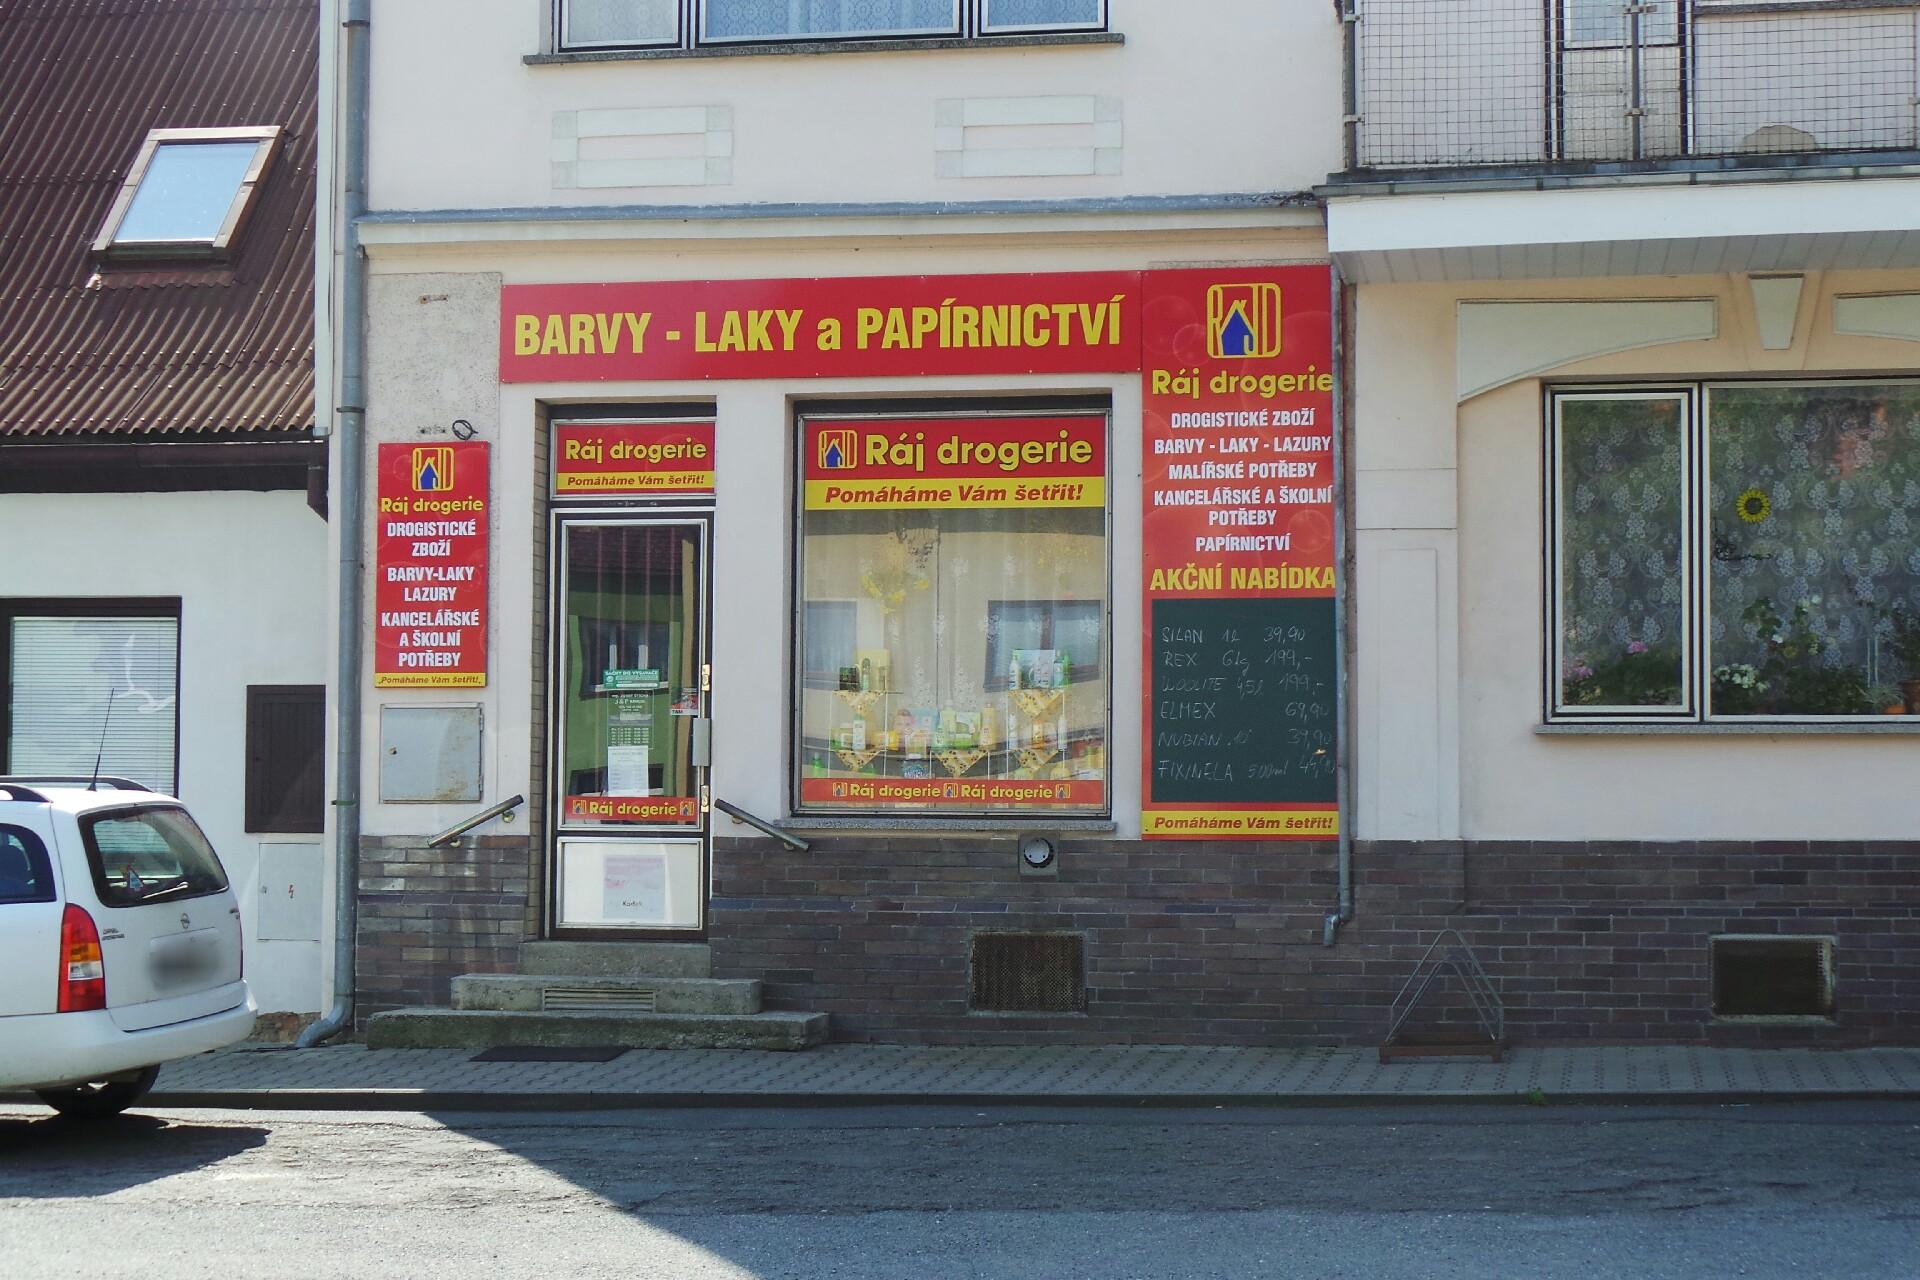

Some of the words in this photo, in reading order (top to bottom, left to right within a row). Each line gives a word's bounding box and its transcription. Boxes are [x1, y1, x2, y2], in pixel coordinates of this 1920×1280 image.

[514, 312, 652, 356] BARVY
[694, 309, 803, 352] LAKY
[816, 317, 841, 350] a
[857, 294, 1127, 350] PAPÍRNICTVÍ
[1152, 367, 1200, 399] Ráj
[1209, 365, 1333, 398] drogerie
[1171, 409, 1268, 428] DROGISTICKÉ
[1272, 408, 1315, 426] ZBOŽÍ
[565, 438, 603, 464] Ráj
[609, 437, 707, 463] drogerie
[865, 431, 925, 472] Ráj
[937, 429, 1093, 471] drogerie
[1154, 439, 1205, 454] BARVY
[1219, 438, 1259, 453] LAKY
[1273, 436, 1331, 452] LAZURY
[1169, 461, 1244, 479] MALÍŘSKÉ
[1249, 460, 1317, 479] POTŘEBY
[567, 476, 635, 486] Pomáháme
[638, 475, 664, 485] Vám
[668, 475, 704, 484] šetřit!
[825, 486, 951, 503] Pomáháme
[957, 485, 1007, 501] Vám
[1014, 483, 1084, 500] šetřit!
[1154, 486, 1261, 506] KANCELÁŘSKÉ
[1265, 489, 1275, 504] A
[1280, 485, 1333, 504] ŠKOLNÍ
[381, 497, 408, 515] Ráj
[412, 496, 484, 515] drogerie
[1209, 508, 1277, 526] POTŘEBY
[387, 519, 476, 537] DROGISTICKÉ
[412, 540, 450, 557] ZBOŽÍ
[1196, 533, 1291, 552] PAPÍRNICTVÍ
[387, 567, 474, 582] BARVY-LAKY
[1150, 562, 1222, 591] AKČNÍ
[1231, 562, 1336, 590] NABÍDKA
[404, 587, 457, 602] LAZURY
[381, 609, 479, 627] KANCELÁŘSKÉ
[399, 632, 409, 646] A
[412, 628, 461, 646] ŠKOLNÍ
[398, 650, 461, 667] POTŘEBY
[1163, 651, 1198, 667] REX
[1160, 701, 1216, 720] ELMEX
[849, 783, 875, 798] Ráj
[879, 783, 941, 799] drogerie
[961, 784, 986, 799] Ráj
[990, 784, 1053, 799] drogerie
[589, 802, 613, 817] Ráj
[617, 802, 678, 817] drogerie
[1154, 816, 1242, 829] Pomáháme
[1247, 817, 1280, 829] Vám
[1285, 816, 1333, 829] šetřit!
